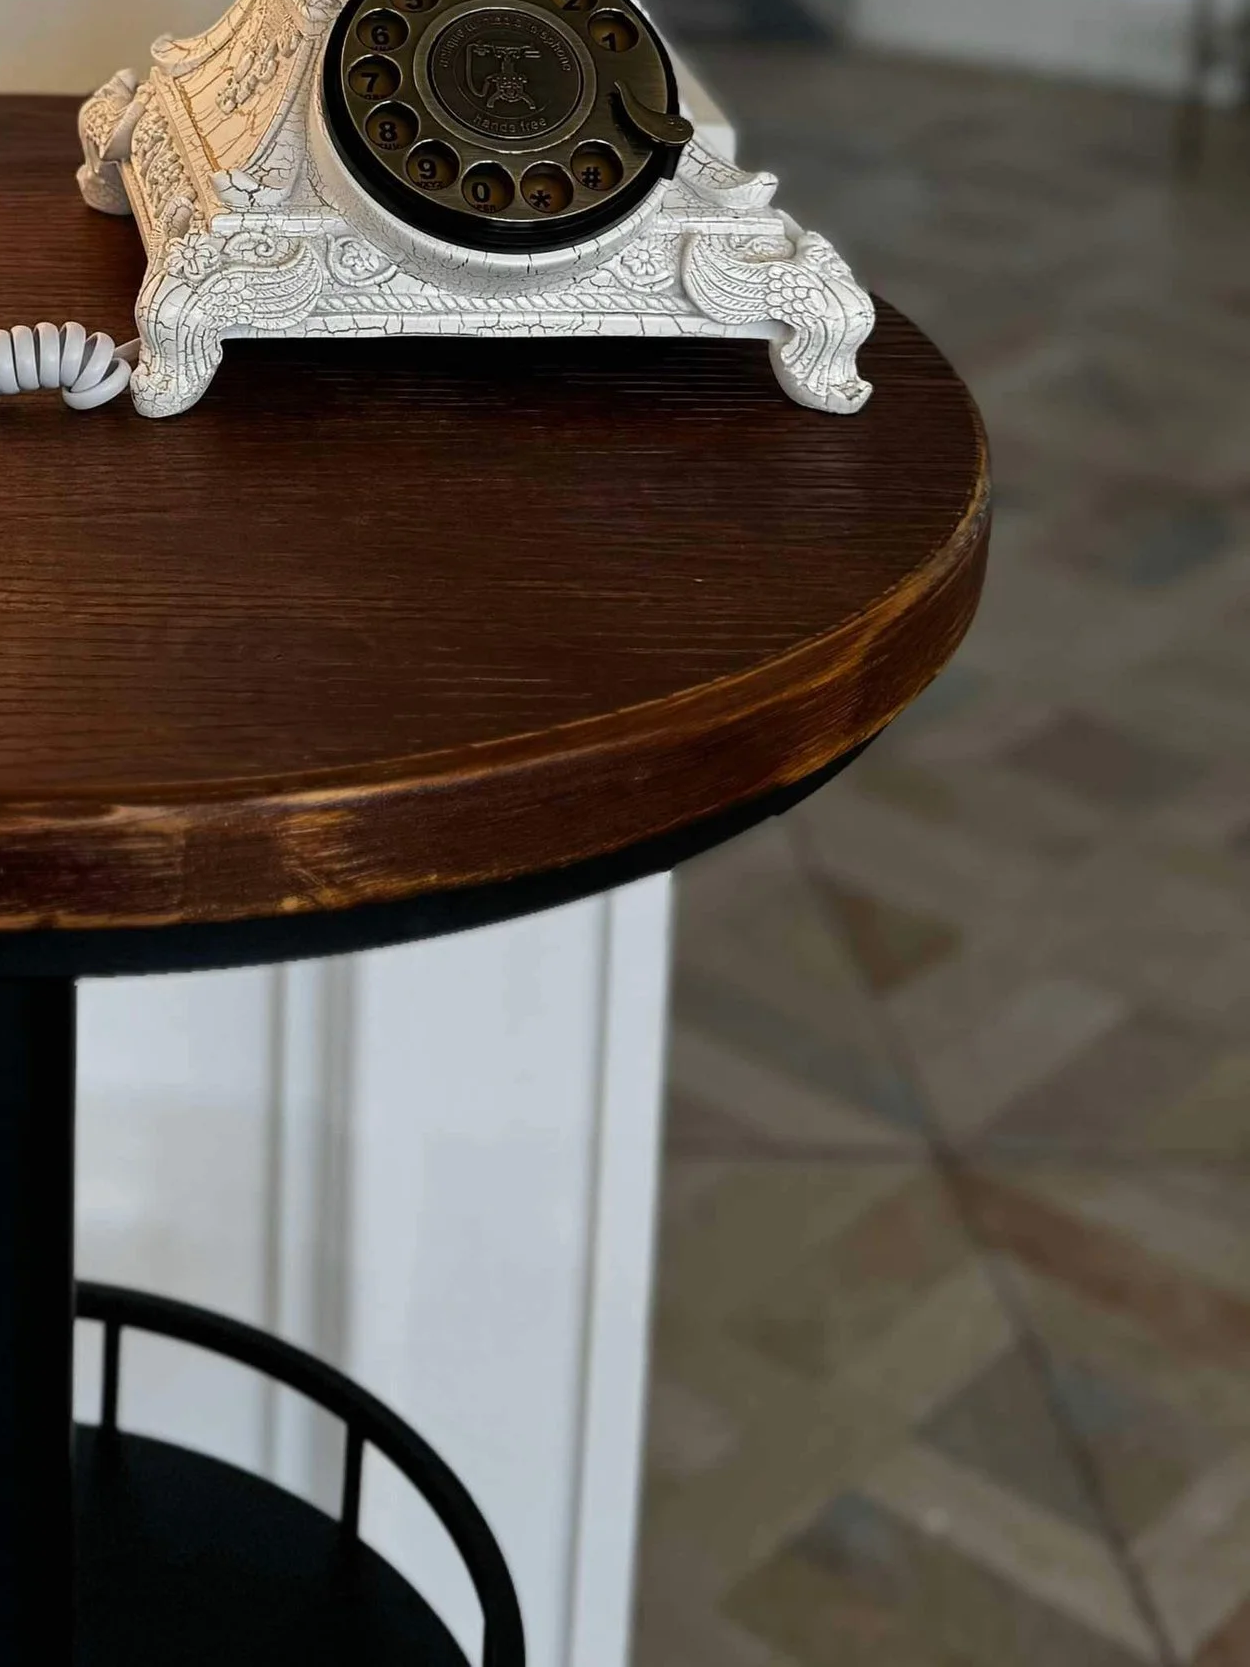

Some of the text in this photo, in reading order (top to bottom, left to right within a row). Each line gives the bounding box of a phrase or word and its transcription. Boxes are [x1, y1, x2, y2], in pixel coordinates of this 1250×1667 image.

[371, 25, 389, 46] 6
[602, 34, 617, 52] 1
[361, 72, 380, 93] 7
[378, 121, 398, 142] 8
[473, 114, 546, 133] hands free
[417, 159, 437, 180] 9
[472, 182, 491, 202] 0
